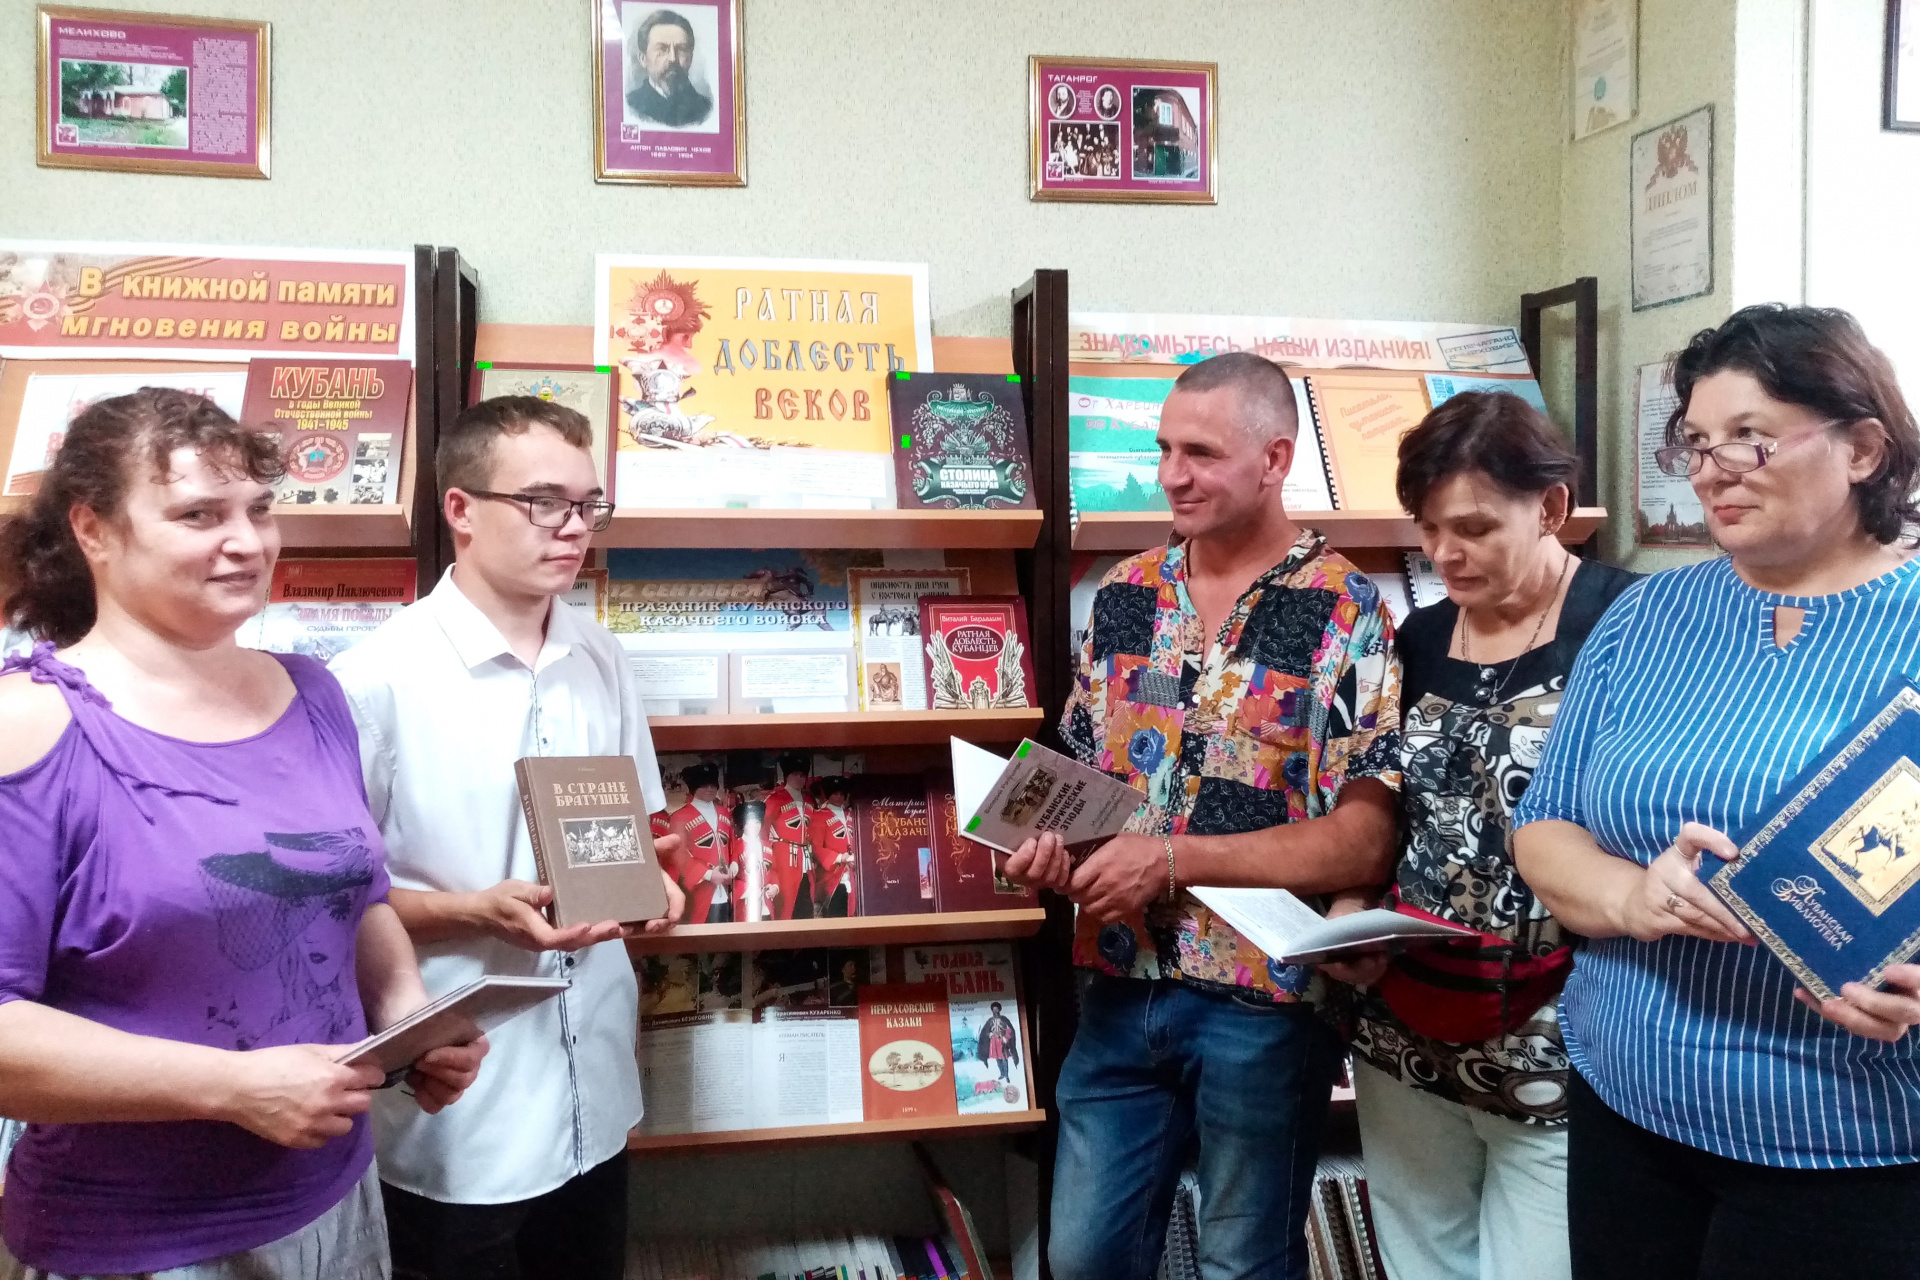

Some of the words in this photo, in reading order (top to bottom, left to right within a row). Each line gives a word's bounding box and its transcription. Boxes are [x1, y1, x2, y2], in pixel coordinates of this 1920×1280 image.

[58, 26, 126, 39] МЕЛИХОВО
[1047, 74, 1098, 83] ТАГАНРОГ
[1643, 180, 1698, 214] ДИПЛОМ
[78, 266, 104, 297] В
[121, 271, 270, 302] книжной
[278, 279, 396, 306] памяти
[733, 286, 880, 325] РАТНАЯ
[60, 315, 267, 341] мгновения
[280, 315, 400, 343] войны
[1079, 332, 1242, 357] ЗНАКОМЬТЕСЬ
[1253, 336, 1320, 359] НАШИ
[1324, 338, 1432, 361] ИЗДАНИЯ!
[714, 338, 906, 376] ДОБЛЕСТЬ
[270, 367, 385, 399] КУБАНЬ
[296, 401, 320, 410] годы
[323, 400, 361, 409] Великой
[754, 387, 872, 421] ВЕКОВ
[274, 409, 341, 418] Отечественной
[343, 410, 373, 419] войны
[296, 419, 349, 430] 1941-1945
[1110, 418, 1159, 431] КУБАН
[940, 468, 998, 482] СТОЛИЦА
[941, 481, 979, 489] КАЗАЧЬЕГО
[980, 481, 999, 489] КРАЯ
[283, 584, 334, 600] Владимир
[337, 583, 404, 598] Павлюченков
[610, 583, 636, 600] 12
[641, 582, 766, 598] СЕНТЯБРЯ
[870, 581, 912, 590] ОПАСНОСТЬ
[915, 581, 929, 590] ДЛЯ
[931, 581, 949, 590] РУСИ
[878, 591, 911, 600] ВОСТОКА
[619, 600, 722, 614] ПРАЗДНИК
[727, 600, 848, 613] КУБАНСКОГО
[298, 607, 338, 622] ЗНАМЯ
[639, 615, 749, 627] КАЗАЧЬЕГО
[753, 614, 828, 626] ВОЙСКА
[941, 615, 968, 623] Виталий
[957, 630, 991, 638] РАТНАЯ
[952, 644, 999, 653] КУБАНЦЕВ
[953, 637, 996, 646] ДОБЛЕСТЬ
[553, 783, 563, 795] В
[568, 781, 628, 794] СТРАНЕ
[555, 793, 630, 807] БРАТУШЕК
[1034, 782, 1073, 831] КУБАНСКИЕ
[1043, 779, 1088, 833] СТОРИЧЕСКИЕ
[1060, 799, 1087, 832] ЭТЮДЫ
[932, 951, 984, 969] РОДНАЯ
[870, 1002, 936, 1015] НЕКРАСОВСКИЕ
[886, 1016, 922, 1029] КАЗАКИ
